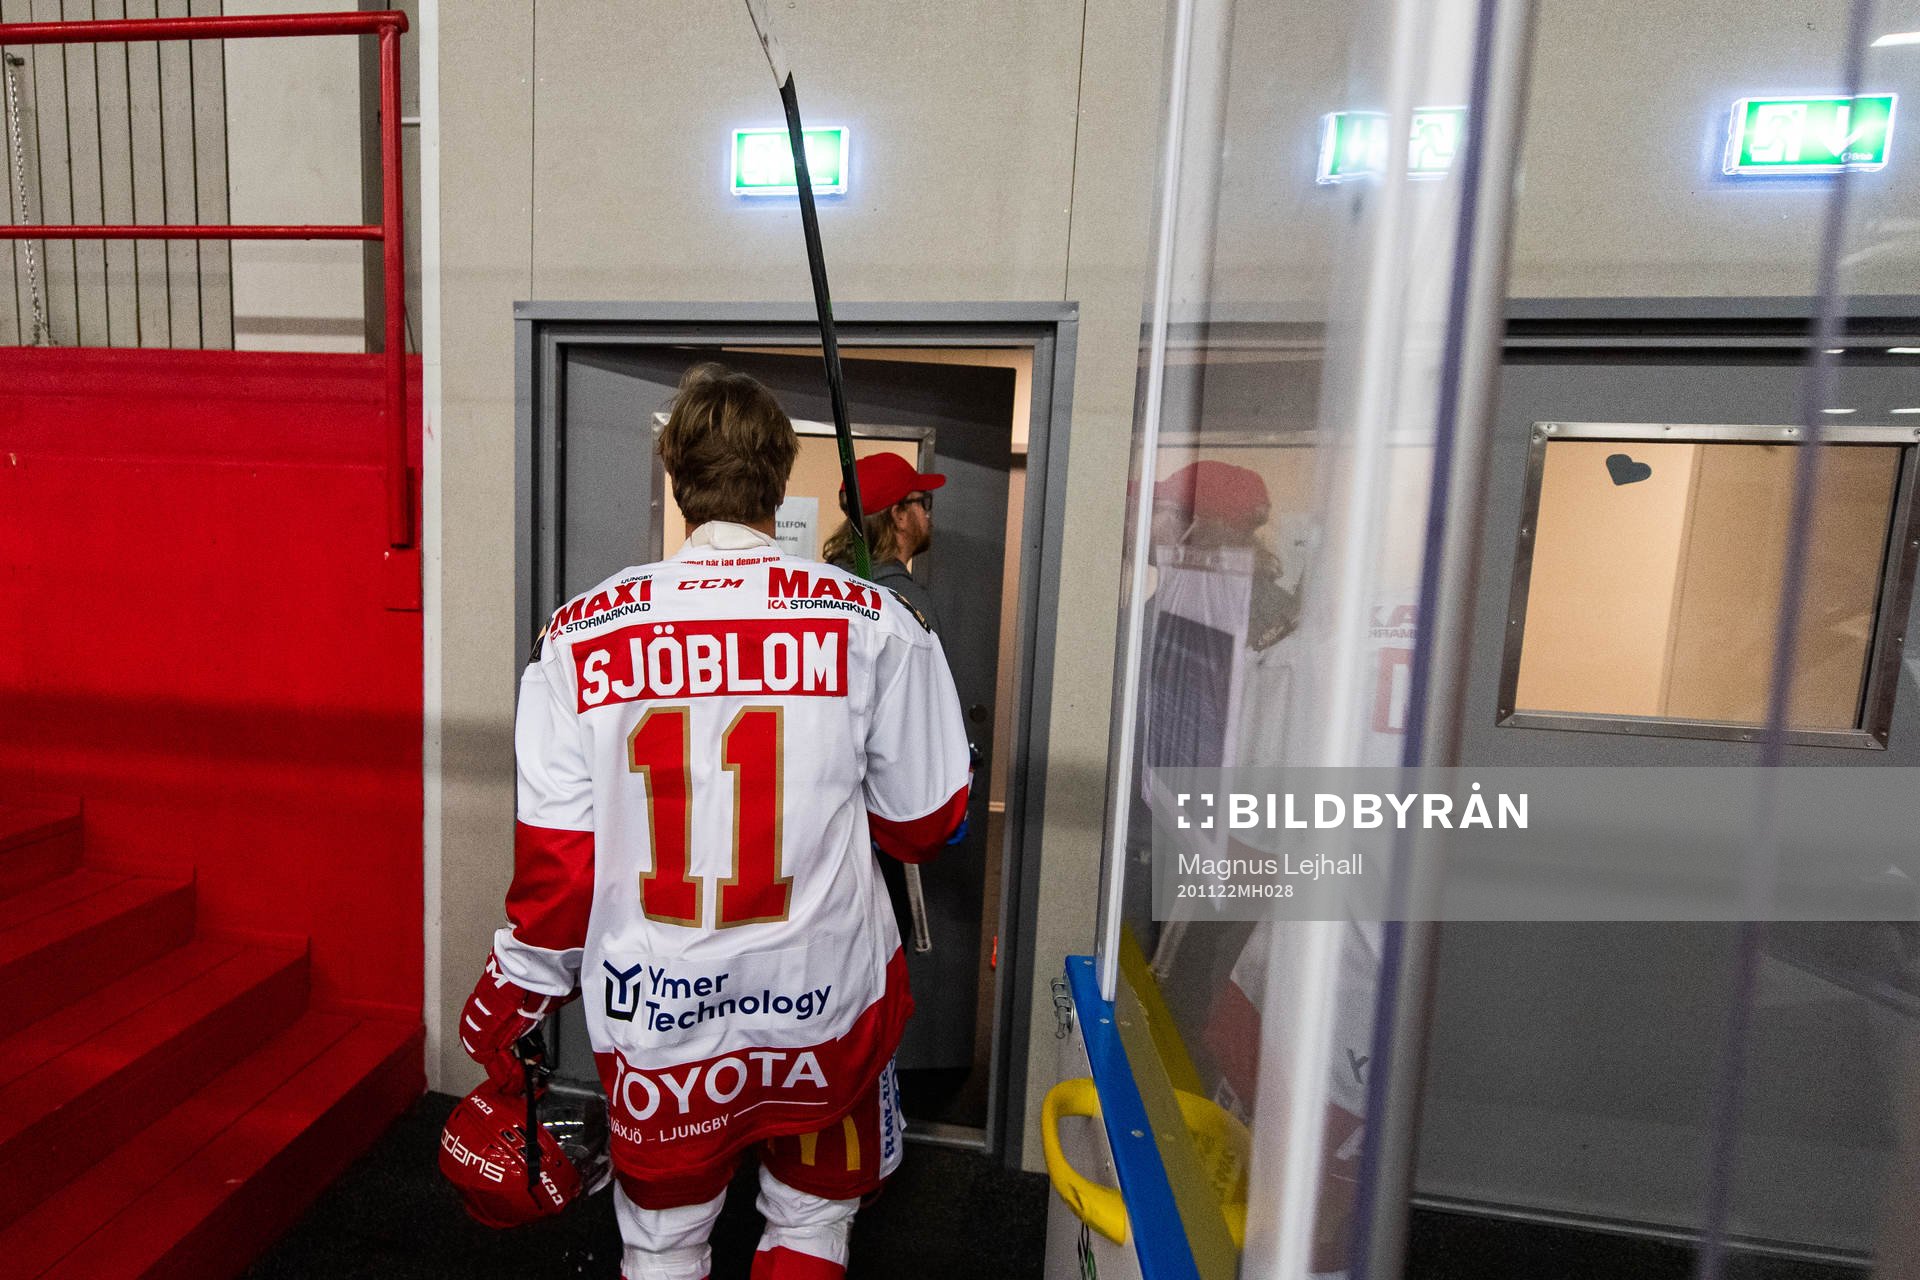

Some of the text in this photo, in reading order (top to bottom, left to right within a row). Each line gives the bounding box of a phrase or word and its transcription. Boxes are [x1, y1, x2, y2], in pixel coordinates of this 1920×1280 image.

[678, 578, 744, 590] CCM
[768, 567, 882, 611] MAXI
[550, 580, 652, 634] MAXI
[566, 602, 651, 634] STORMARKNAD
[768, 600, 880, 622] ICA STORMARKNAD
[582, 624, 839, 706] SJÖBLOM
[627, 705, 794, 931] 11
[648, 966, 729, 999] Ymer
[645, 985, 832, 1032] Technology
[612, 1051, 829, 1121] TOYOTA
[610, 1116, 642, 1144] VÄXJÖ
[660, 1114, 729, 1142] LJUNGBY
[540, 1171, 564, 1206] CCM
